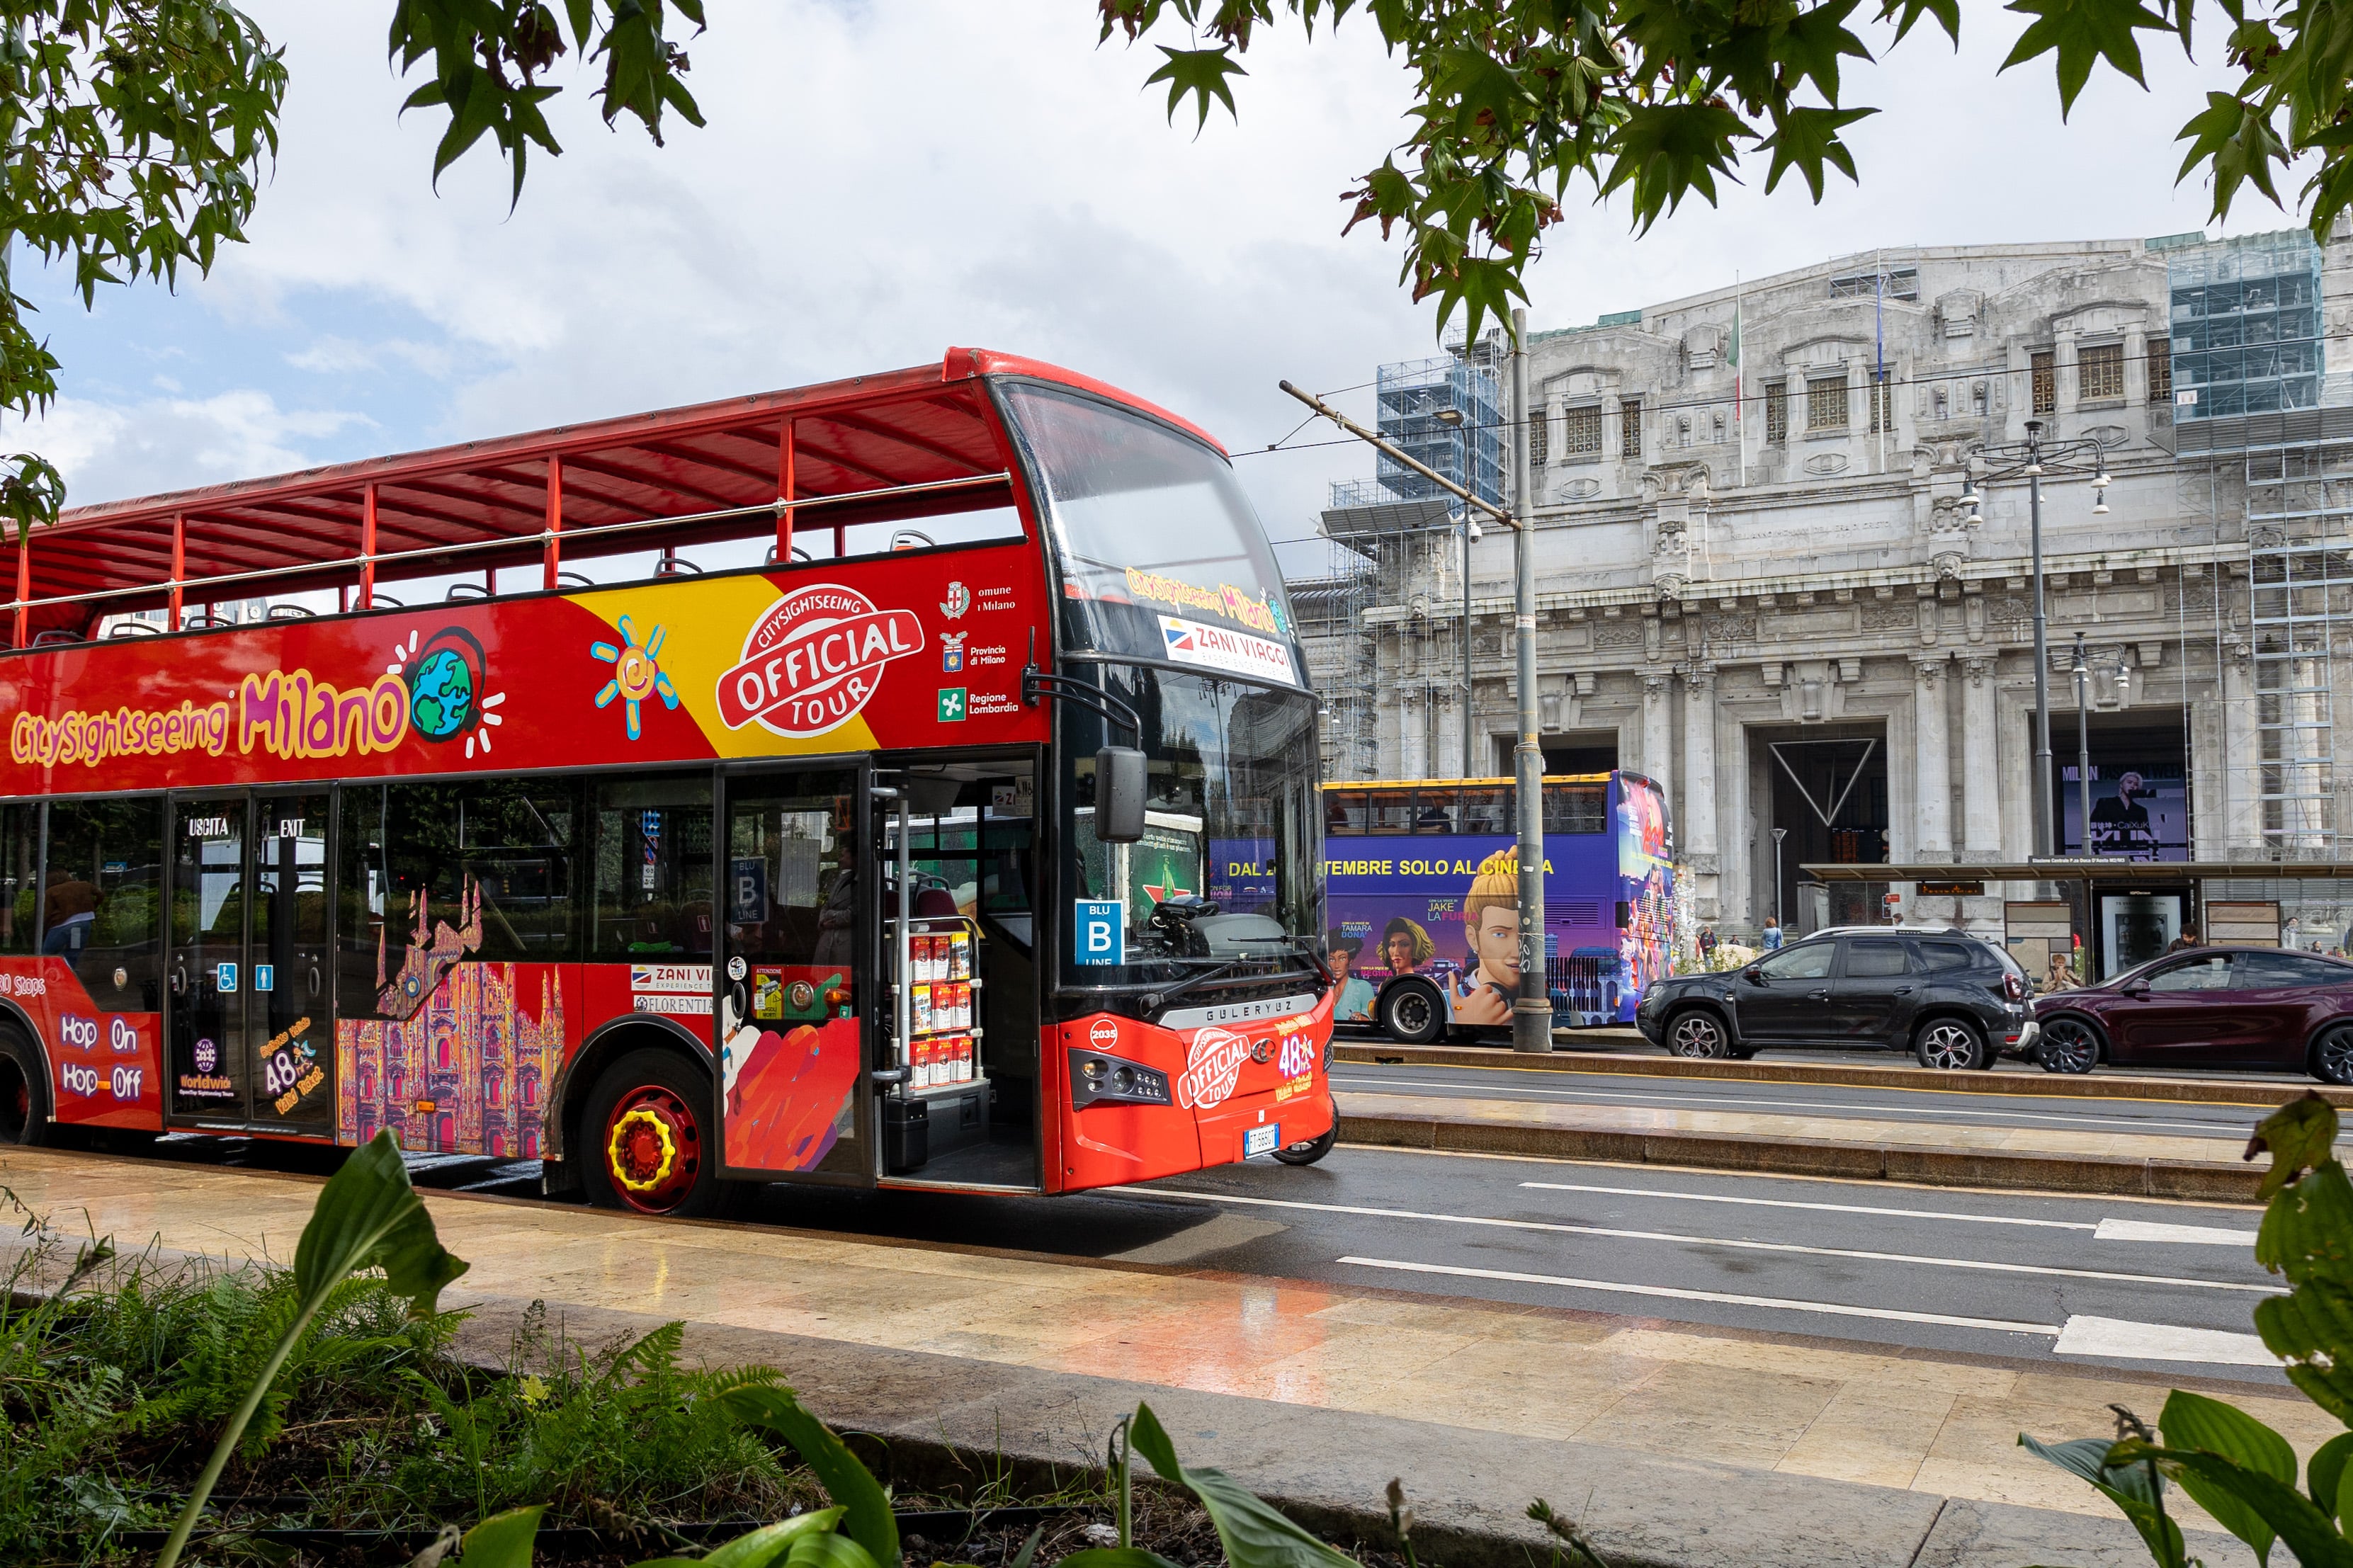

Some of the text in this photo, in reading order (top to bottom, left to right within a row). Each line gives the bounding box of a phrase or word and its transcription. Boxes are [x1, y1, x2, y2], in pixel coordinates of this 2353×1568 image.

[983, 601, 1015, 611] Milano
[1219, 582, 1276, 634] Milano
[757, 595, 861, 648] CITYSIGHTSEEING
[970, 645, 1006, 656] Provincia
[1196, 627, 1289, 667] ZANI VIAGGI
[737, 618, 911, 711] OFFICIAL
[970, 656, 1005, 665] di Milano
[791, 677, 869, 725] TOUR
[970, 693, 1007, 705] Regione
[240, 669, 409, 759] Milano
[970, 703, 1019, 715] Lombardia
[2063, 766, 2097, 780] MILN
[189, 817, 228, 836] USCITA
[280, 819, 306, 837] EXIT
[739, 862, 755, 870] BLU
[1229, 862, 1261, 877] DAL
[1400, 860, 1448, 875] SOLO
[1453, 860, 1477, 875] AL
[1482, 859, 1554, 875] CINEA
[739, 877, 756, 905] B
[738, 911, 758, 919] LINE
[1089, 905, 1110, 915] BLU
[1428, 902, 1454, 912] JAKE
[1089, 921, 1111, 952] B
[657, 968, 713, 981] ZANI VI
[14, 975, 45, 997] Stops
[61, 1014, 137, 1052] Hop On
[1092, 1030, 1117, 1039] 2035
[1279, 1035, 1300, 1077] 48
[266, 1051, 296, 1094] 48
[1187, 1040, 1247, 1097] OFFICIAL
[62, 1062, 142, 1099] Hop Off
[180, 1074, 232, 1090] Worldwide
[1209, 1072, 1235, 1101] TOUR
